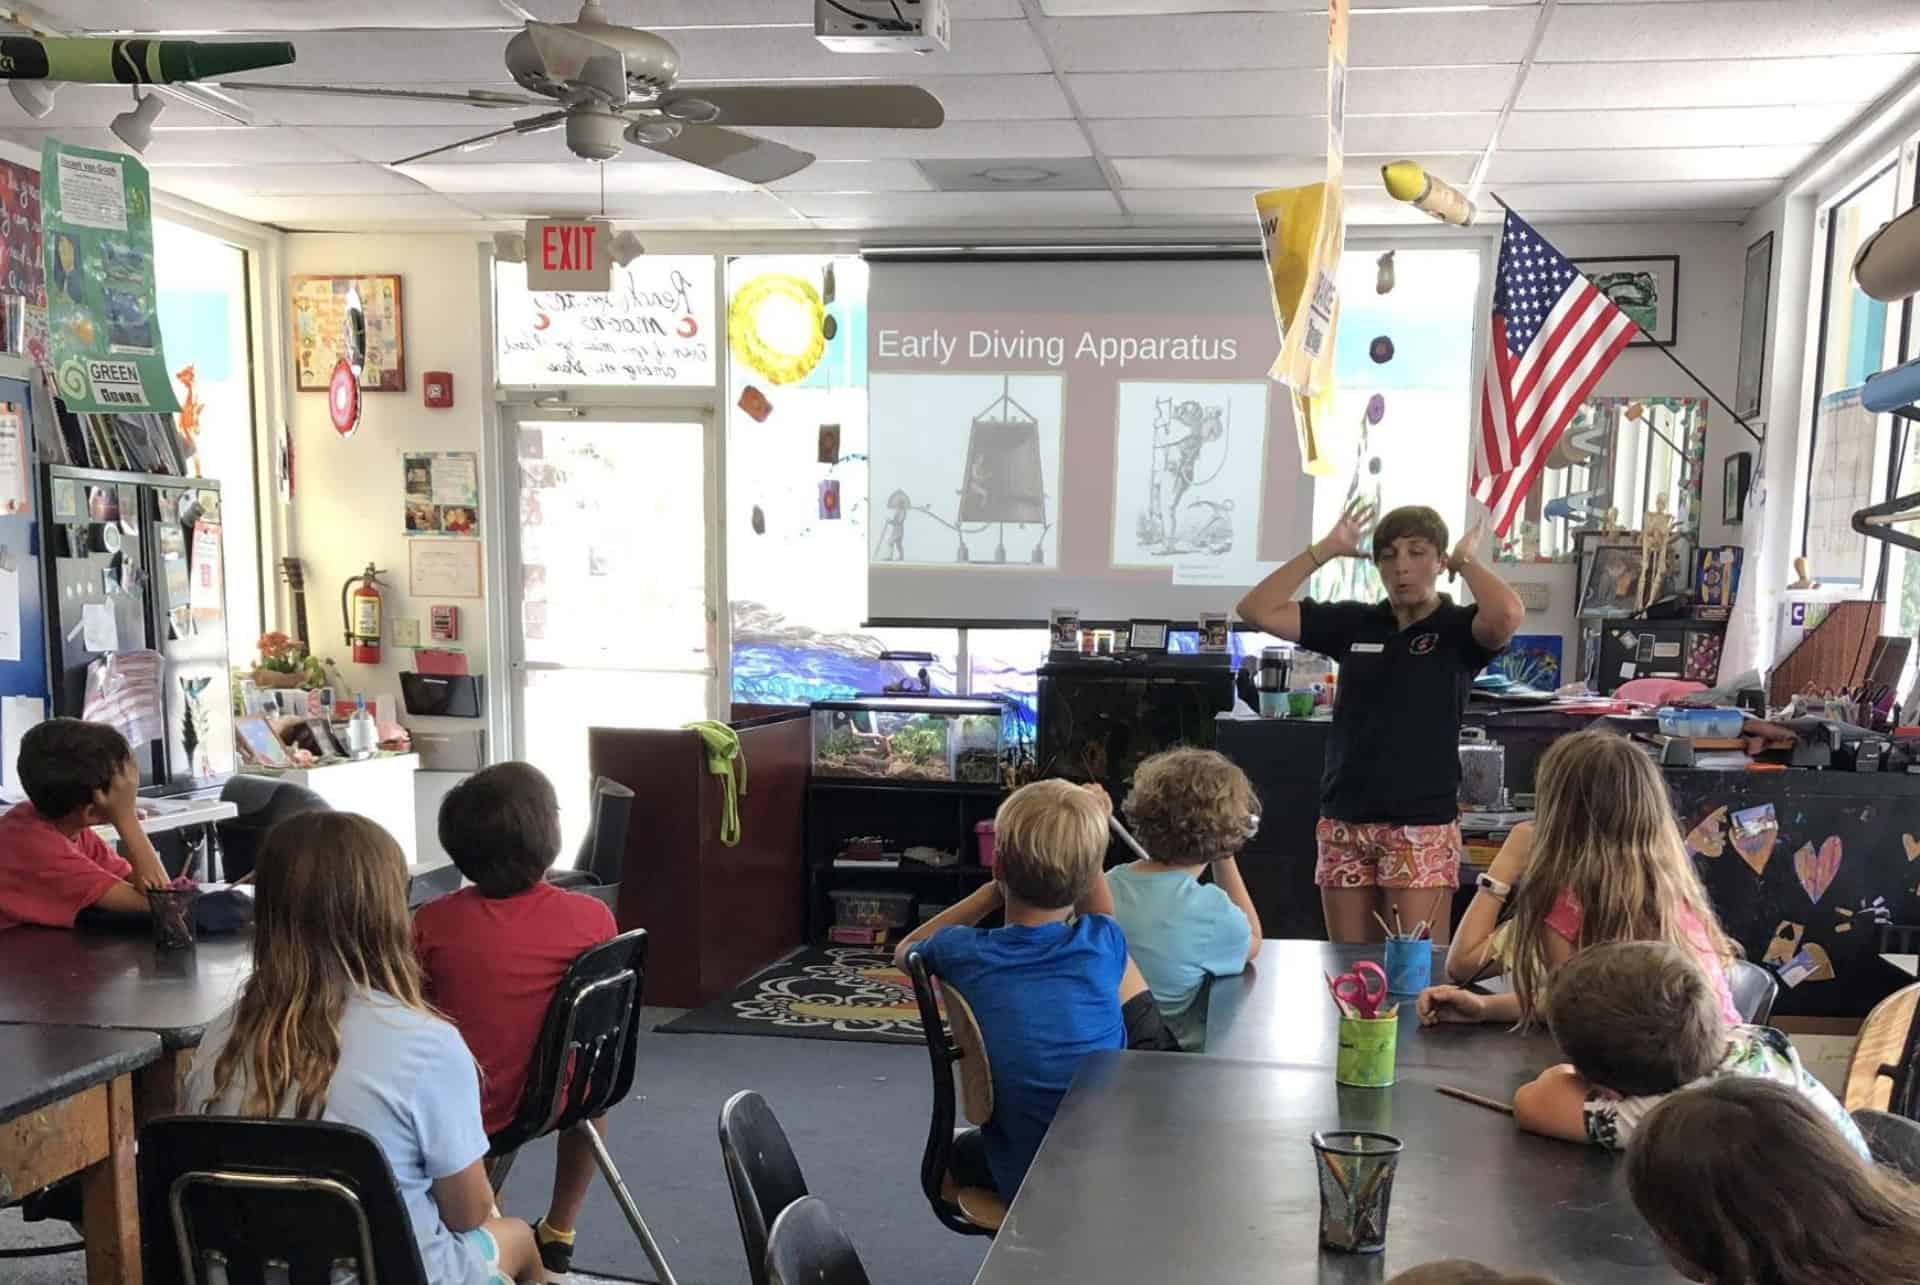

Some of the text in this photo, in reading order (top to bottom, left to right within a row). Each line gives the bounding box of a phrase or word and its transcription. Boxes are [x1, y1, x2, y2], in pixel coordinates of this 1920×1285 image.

[542, 226, 597, 271] EXIT
[878, 329, 1239, 367] Early Diving Apparatus
[90, 363, 139, 382] GREEN
